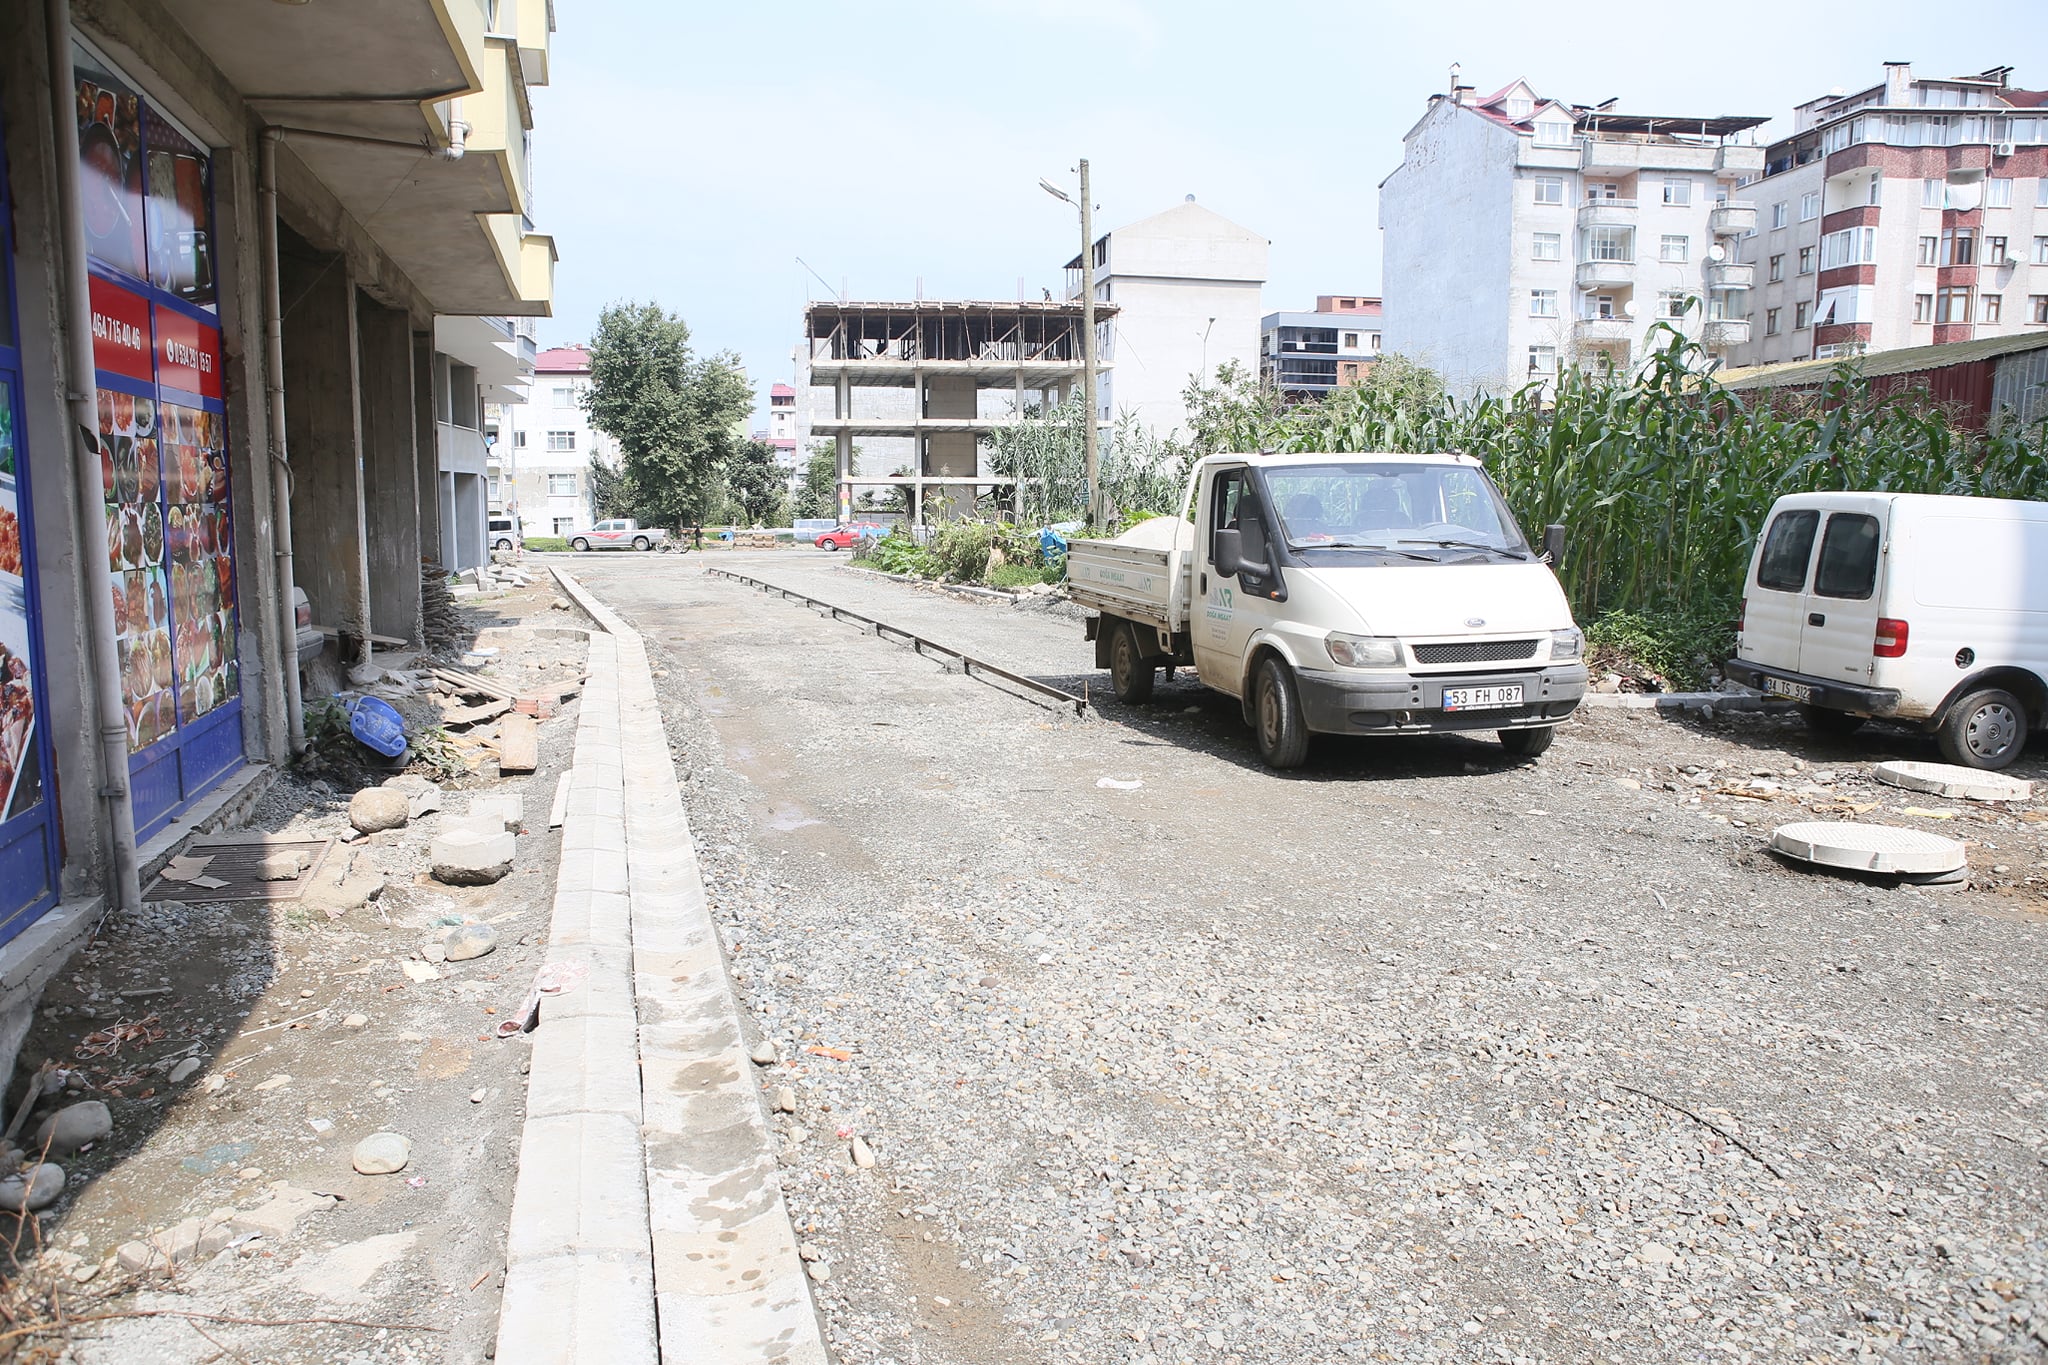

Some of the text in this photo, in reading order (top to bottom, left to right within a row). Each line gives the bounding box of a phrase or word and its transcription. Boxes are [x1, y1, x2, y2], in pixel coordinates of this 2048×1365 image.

[93, 311, 142, 351] 464 715 40 46
[1767, 678, 1777, 691] 34
[1781, 681, 1791, 695] TS
[1452, 687, 1520, 704] 53 FH 087
